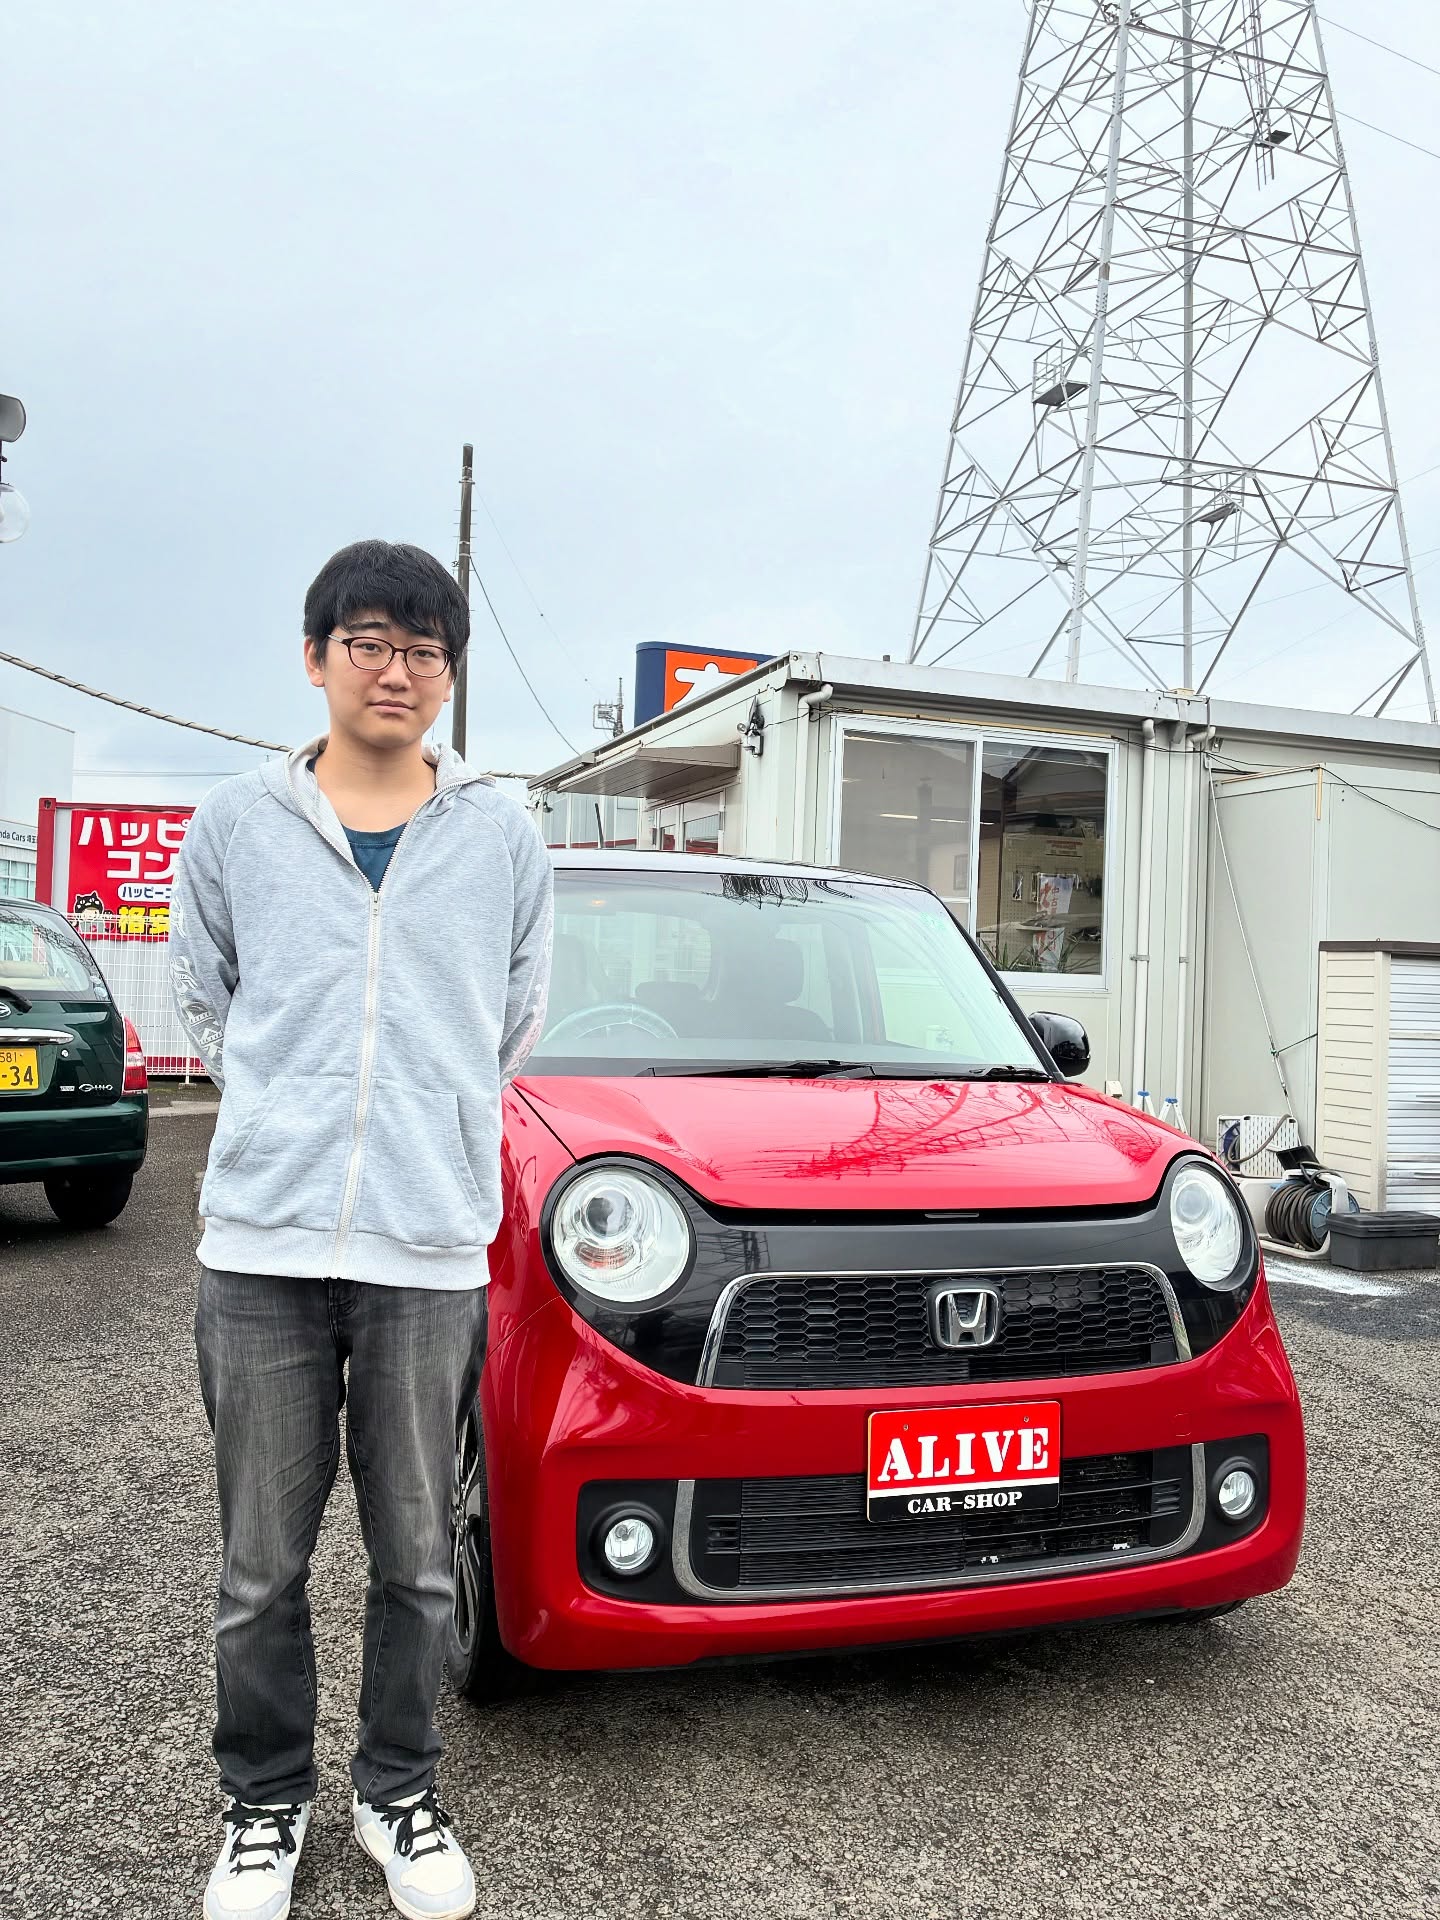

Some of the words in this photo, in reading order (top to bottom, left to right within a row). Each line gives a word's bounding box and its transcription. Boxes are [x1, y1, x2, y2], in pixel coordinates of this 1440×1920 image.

[12, 832, 25, 842] Cars
[107, 850, 178, 880] コン
[118, 906, 169, 934] 格安
[877, 1427, 1049, 1482] ALIVE
[907, 1491, 1023, 1514] CAR-SHOP
